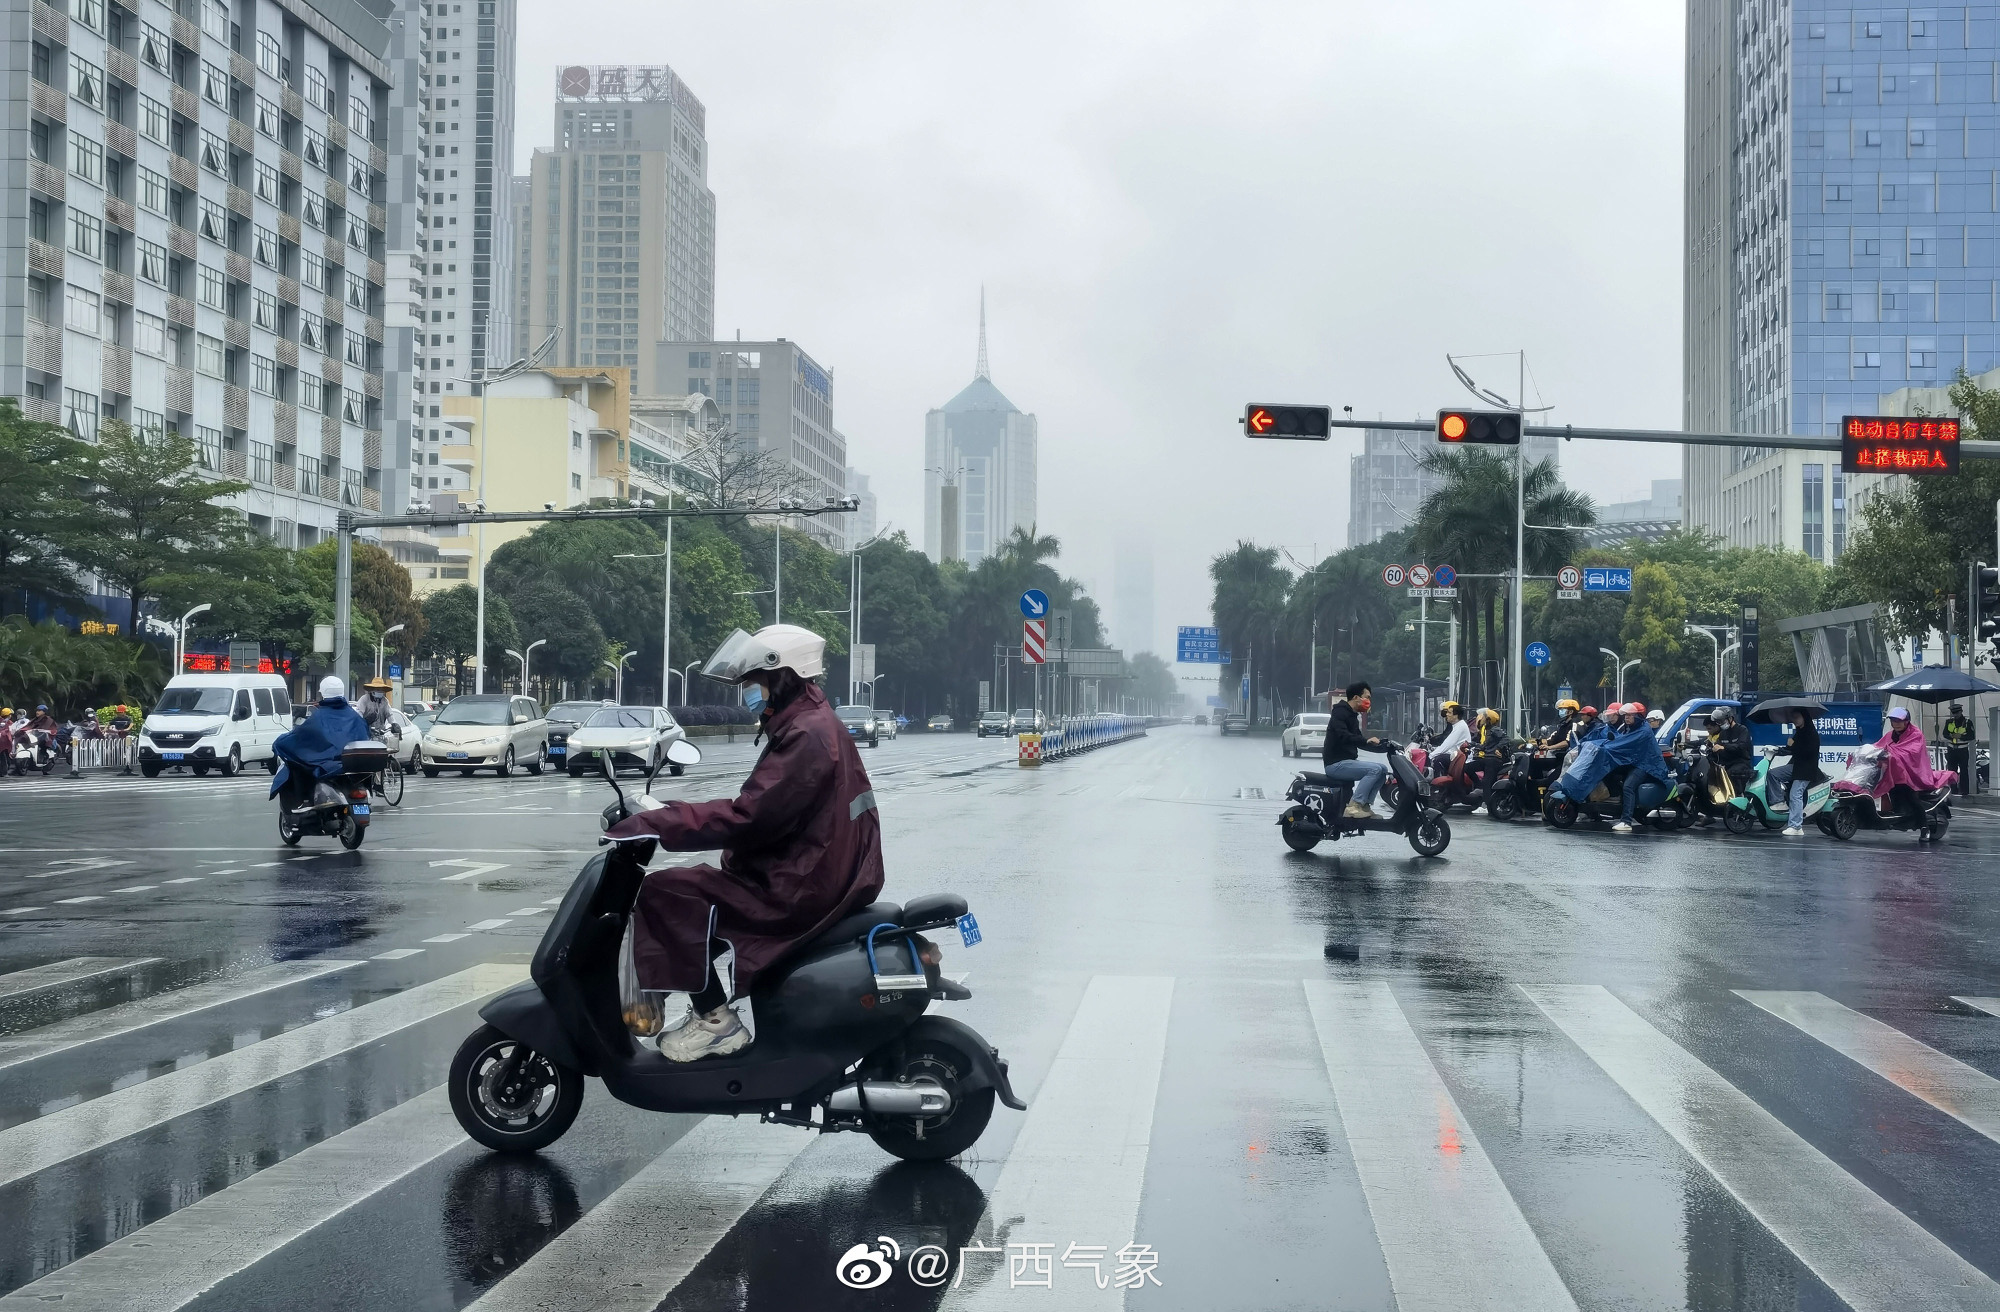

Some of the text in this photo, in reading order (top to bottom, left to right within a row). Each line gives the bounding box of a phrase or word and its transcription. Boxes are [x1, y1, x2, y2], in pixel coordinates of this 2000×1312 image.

[595, 68, 662, 96] 盛天
[1848, 419, 1958, 441] 电动自行车禁
[1856, 447, 1948, 469] 止搭载两人
[1387, 569, 1402, 582] 60
[1562, 571, 1576, 584] 30
[1747, 641, 1754, 649] A
[1819, 752, 1853, 763] 递发
